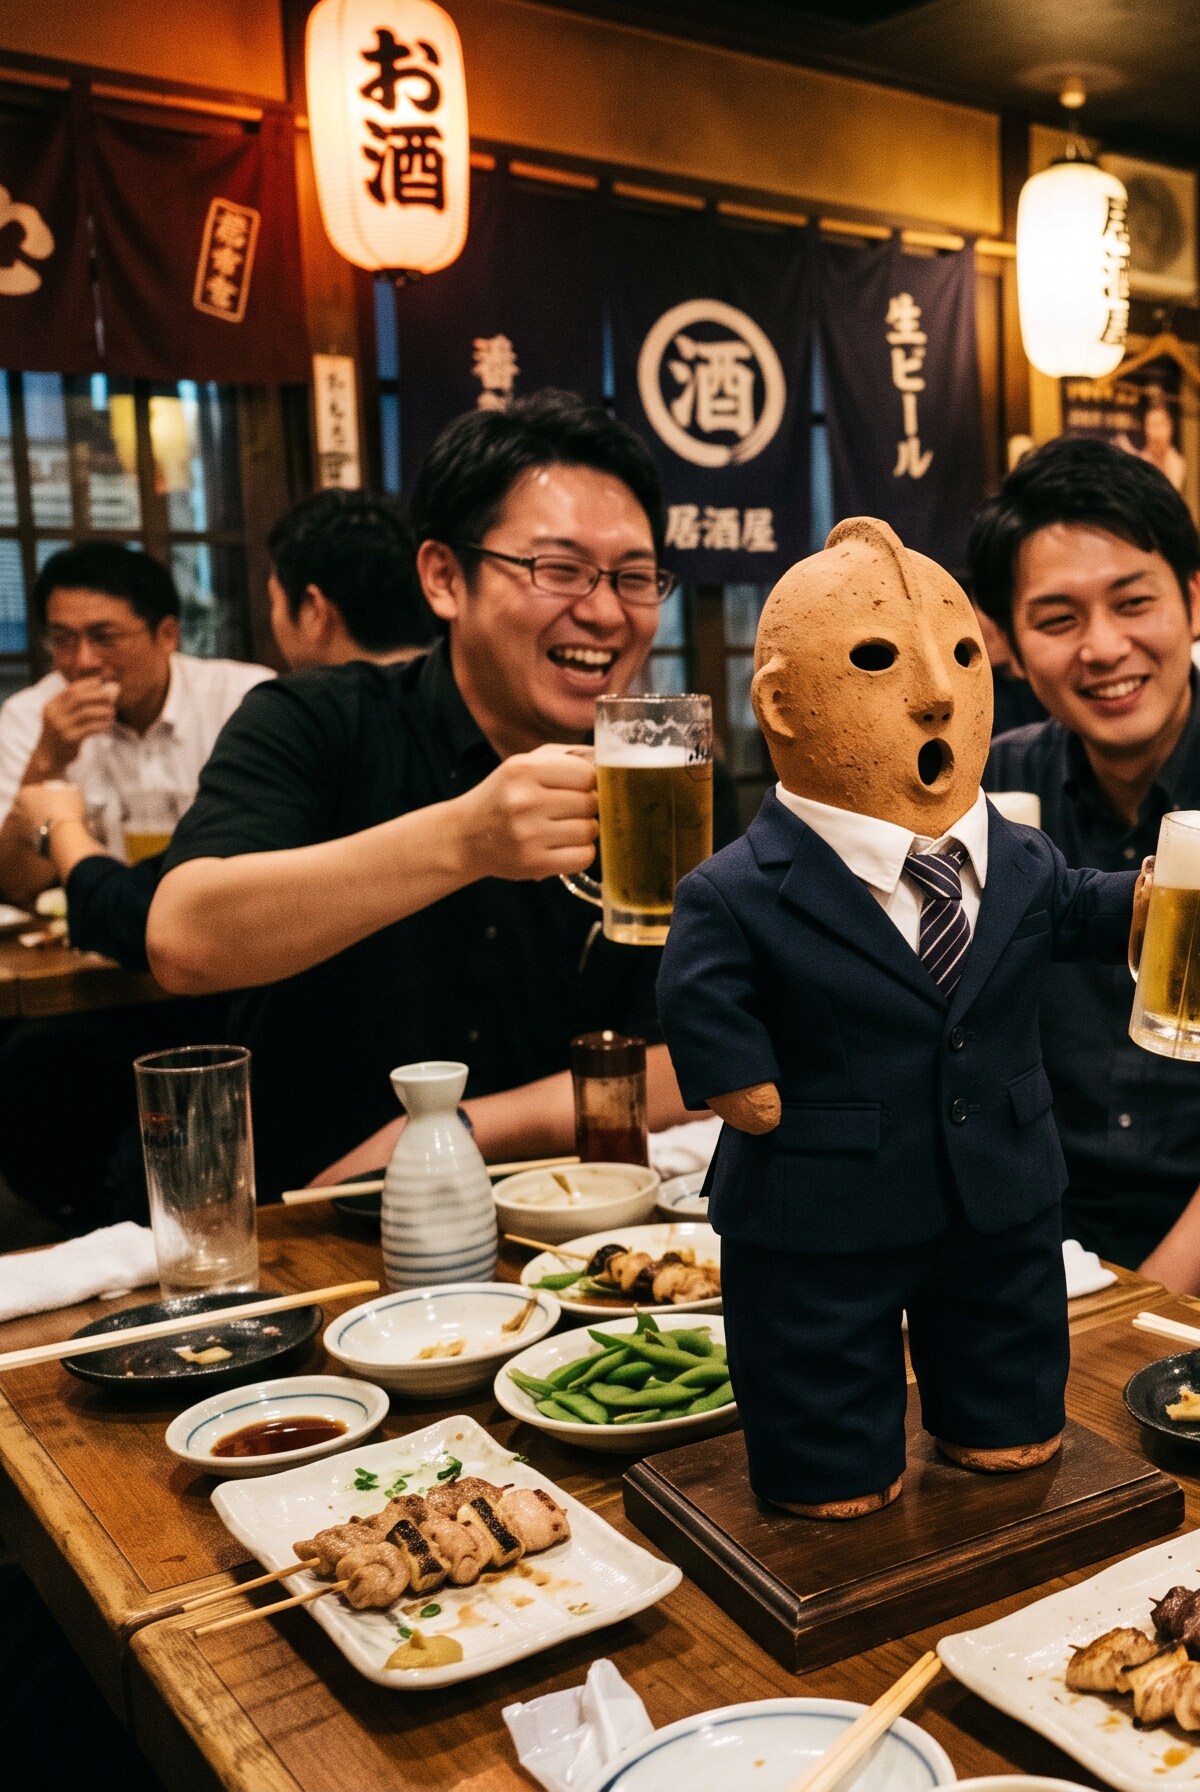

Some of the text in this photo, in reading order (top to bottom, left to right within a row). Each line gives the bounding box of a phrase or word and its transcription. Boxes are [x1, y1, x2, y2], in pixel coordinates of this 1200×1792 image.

[360, 29, 446, 211] お酒
[668, 333, 755, 438] 酒
[884, 292, 934, 479] 生ビール
[664, 503, 778, 553] 居酒屋
